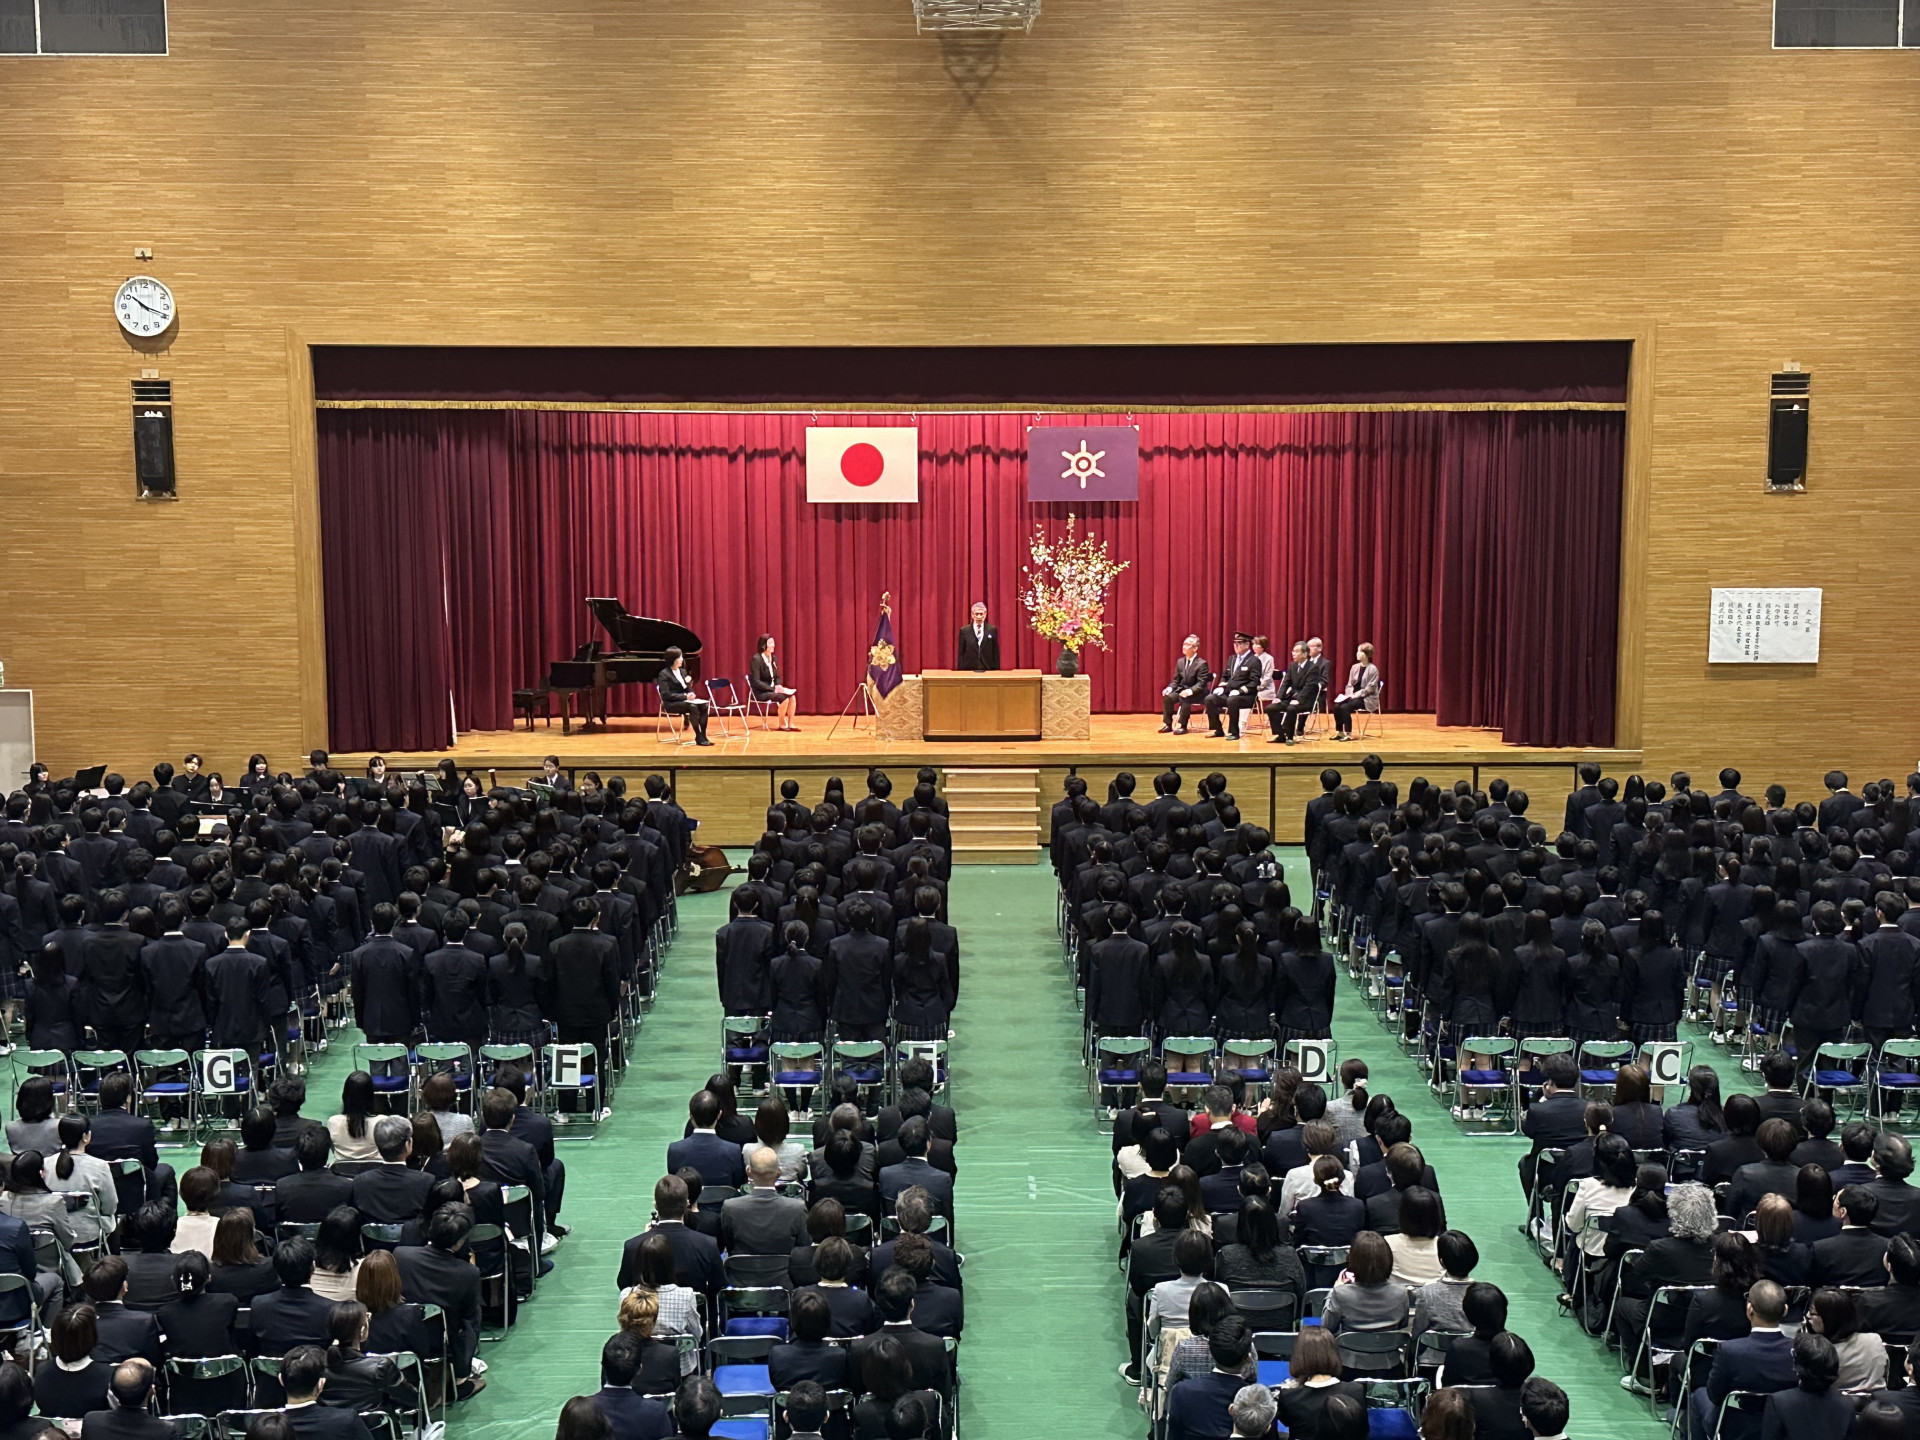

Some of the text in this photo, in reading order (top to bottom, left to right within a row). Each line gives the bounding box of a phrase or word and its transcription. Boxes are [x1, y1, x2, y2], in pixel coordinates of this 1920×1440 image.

[206, 1055, 232, 1089] G
[555, 1049, 579, 1083] F
[1301, 1045, 1326, 1078] D
[1655, 1049, 1680, 1082] C
